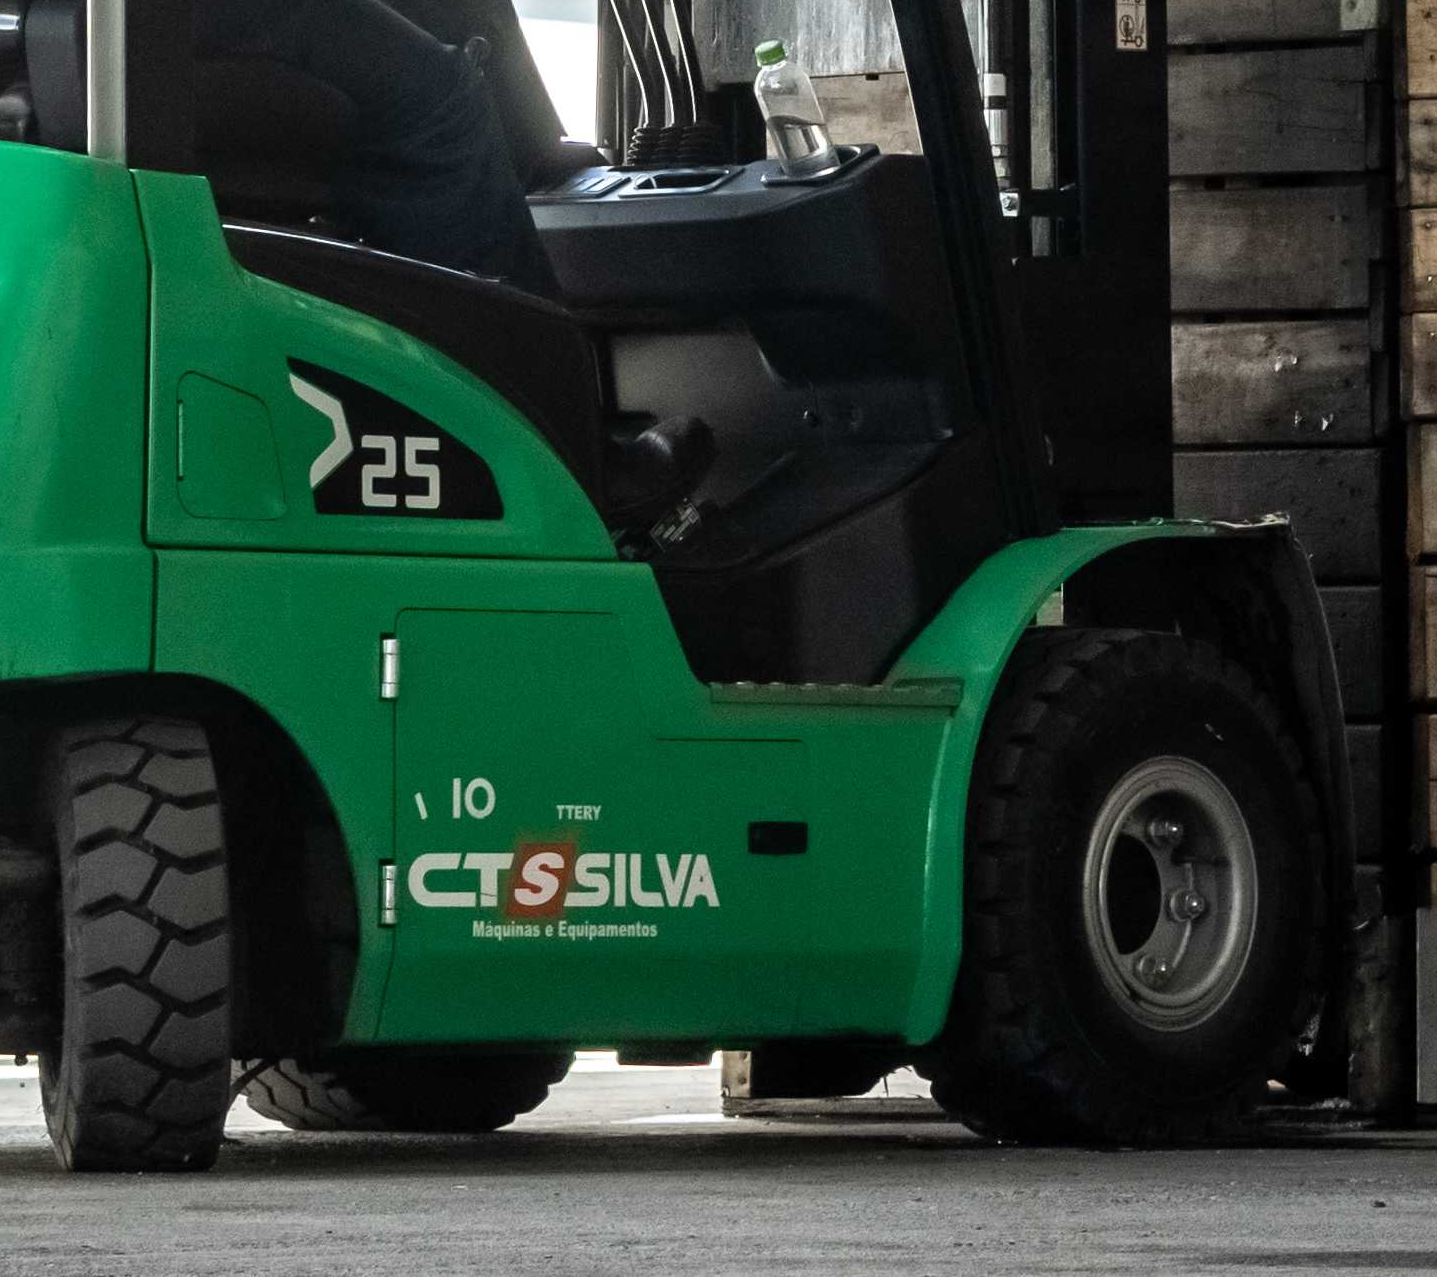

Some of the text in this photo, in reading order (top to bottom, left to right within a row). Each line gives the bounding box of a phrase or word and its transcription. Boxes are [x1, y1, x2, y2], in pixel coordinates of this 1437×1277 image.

[360, 435, 441, 510] 25
[472, 919, 658, 942] Máquinas e Equipamentos
